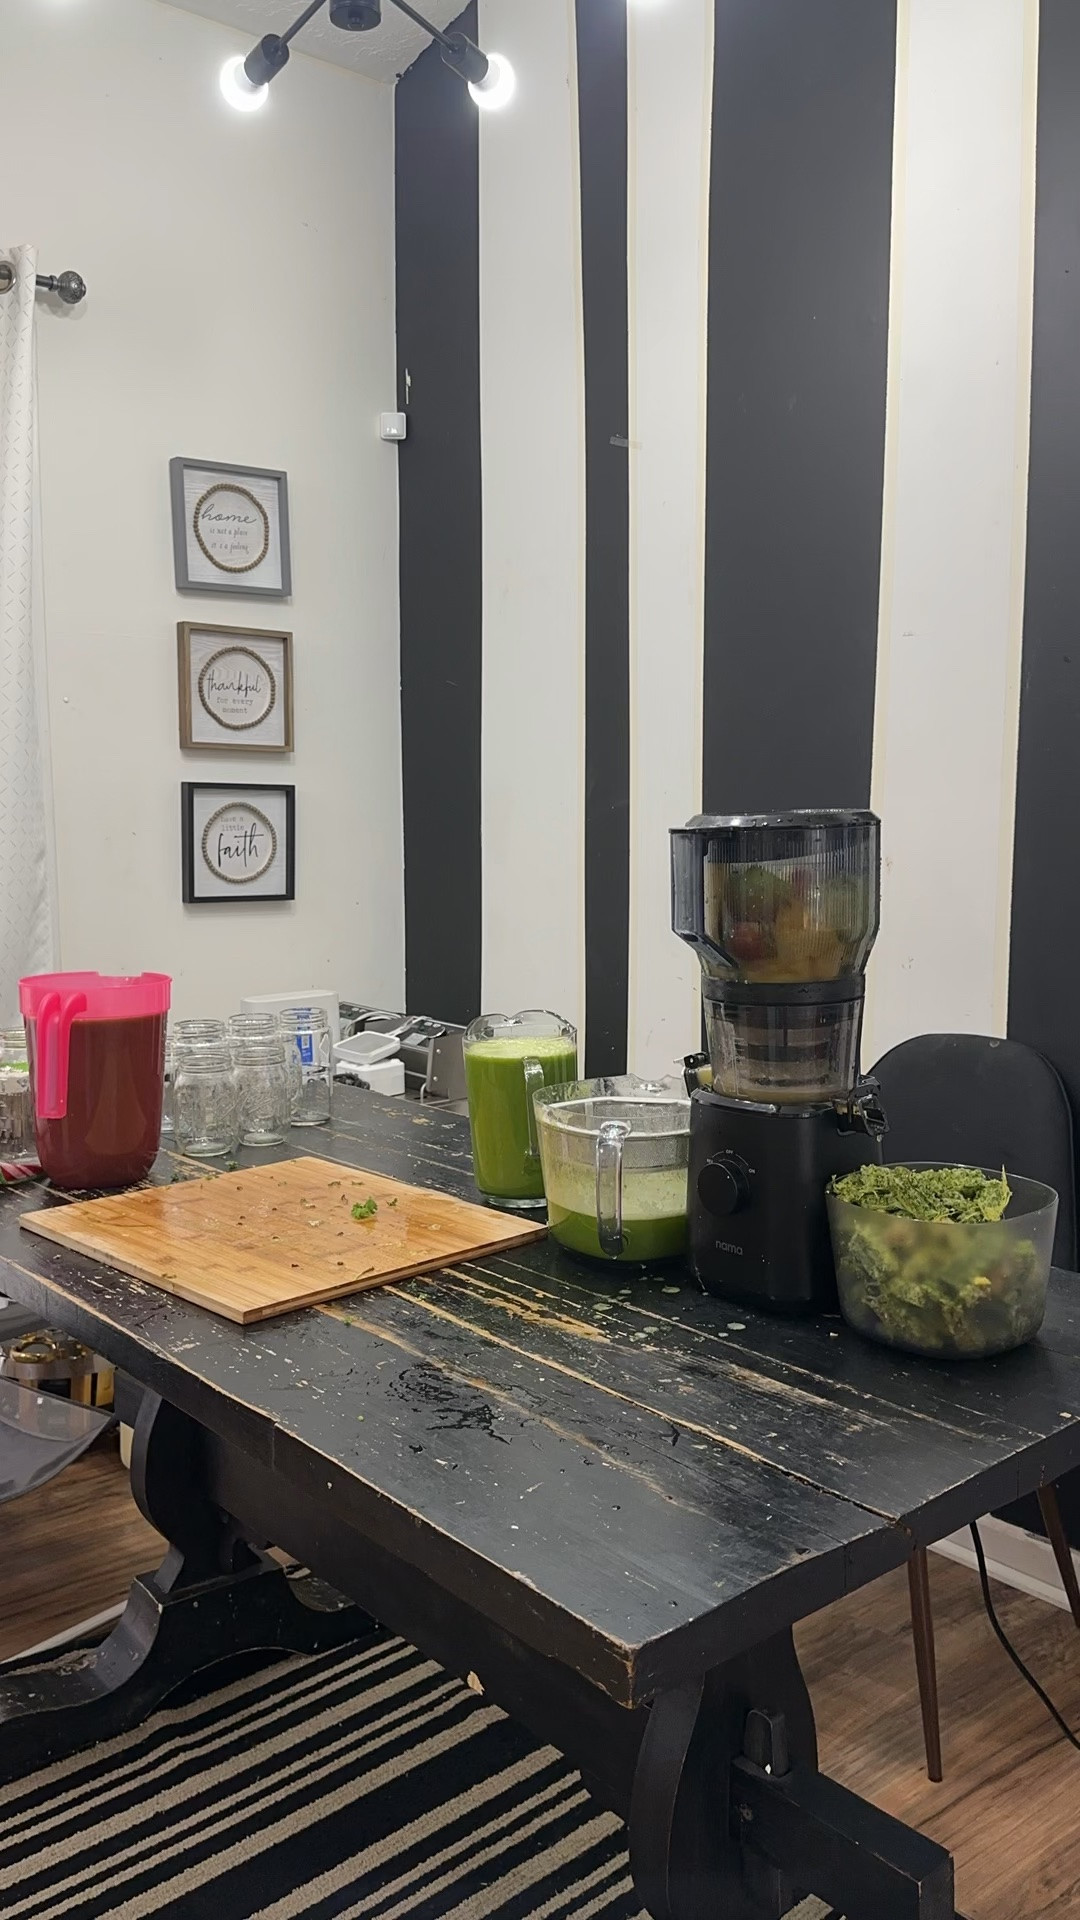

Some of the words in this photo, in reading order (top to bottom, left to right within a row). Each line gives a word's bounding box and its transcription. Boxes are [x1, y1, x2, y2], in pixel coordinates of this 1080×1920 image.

[201, 503, 257, 524] home
[206, 669, 262, 700] thankful
[216, 696, 229, 704] for
[232, 698, 254, 706] every
[217, 822, 265, 868] faith
[715, 1240, 743, 1256] nama
